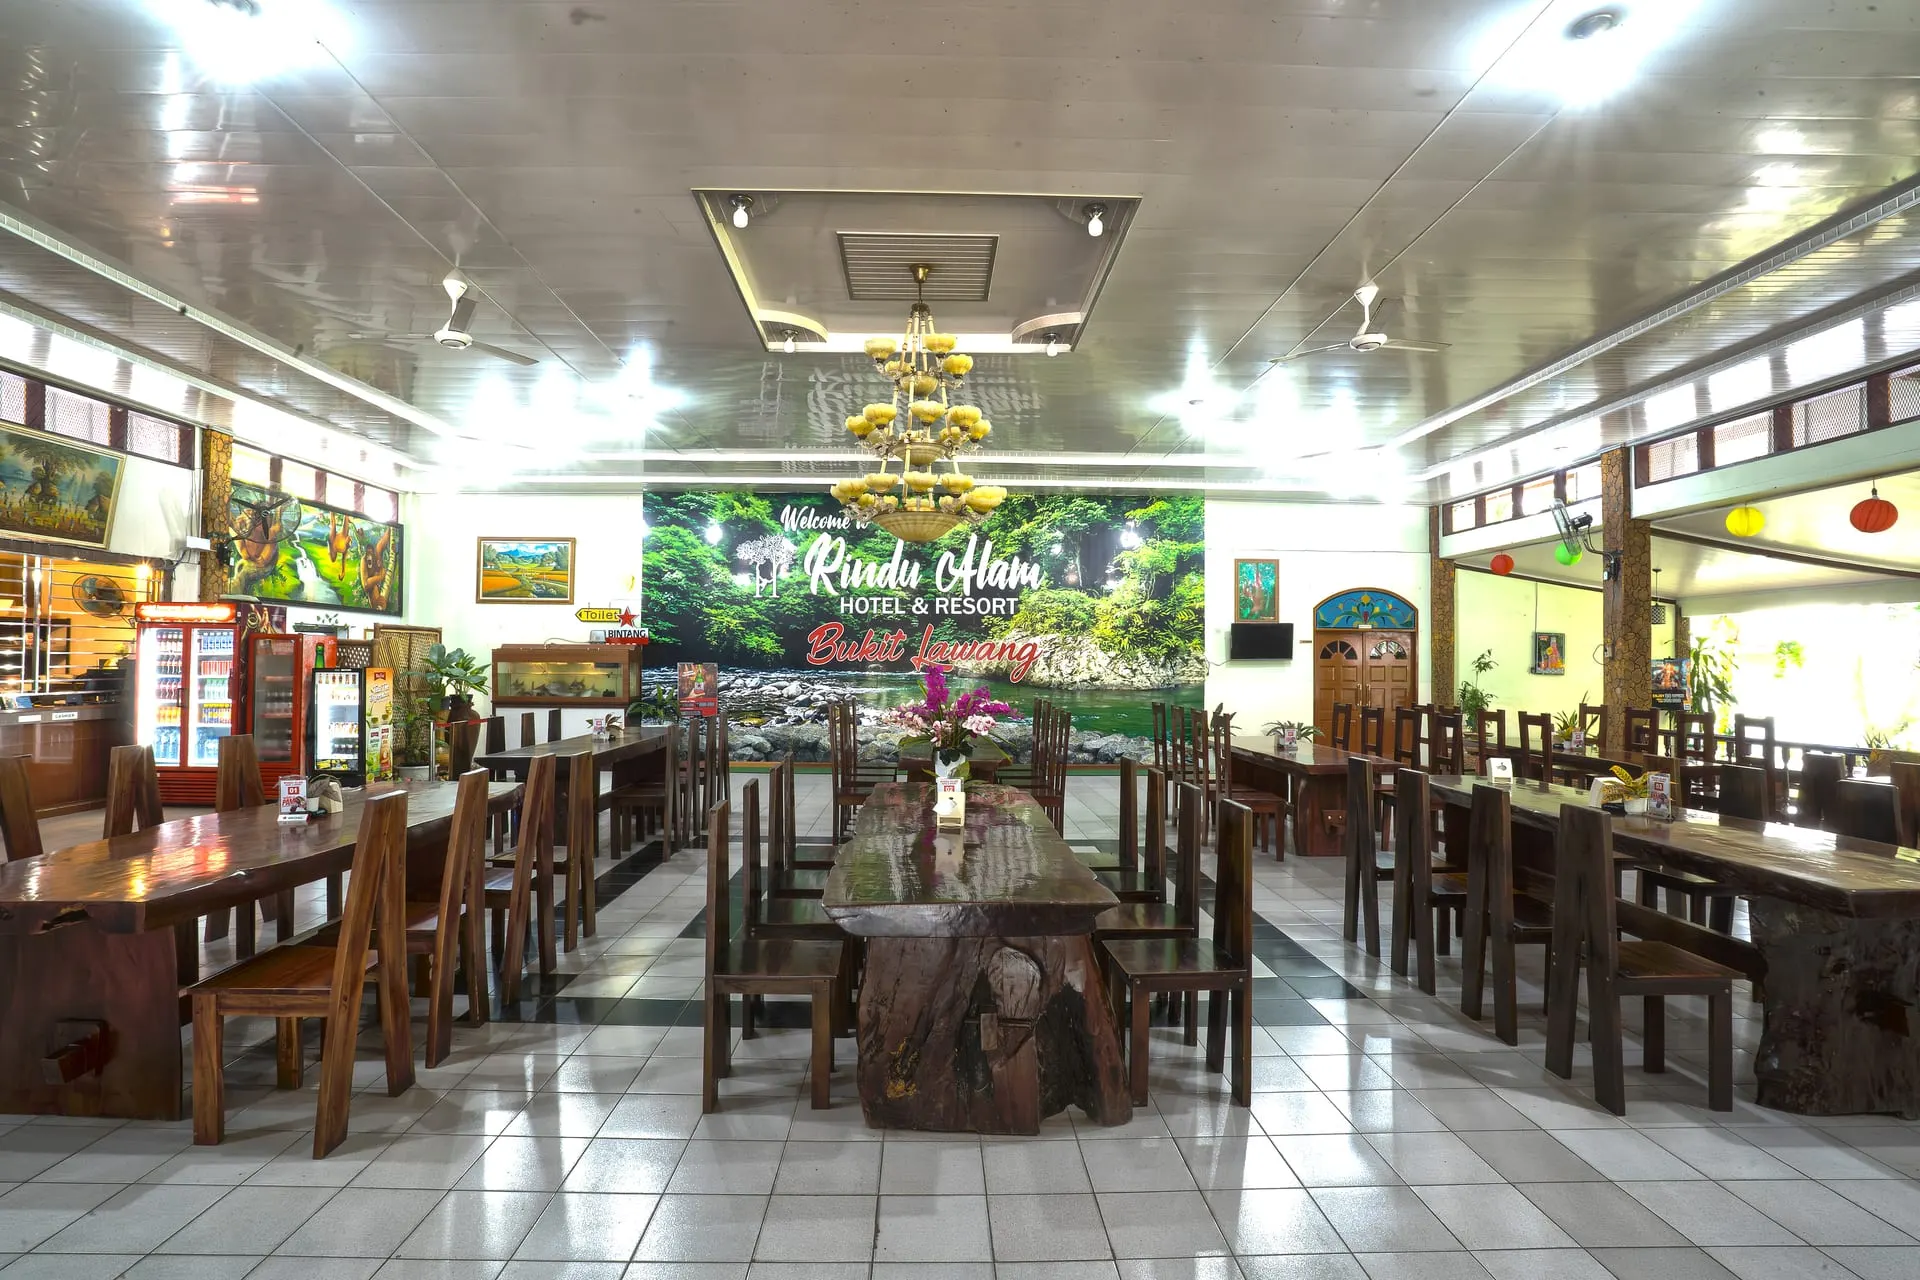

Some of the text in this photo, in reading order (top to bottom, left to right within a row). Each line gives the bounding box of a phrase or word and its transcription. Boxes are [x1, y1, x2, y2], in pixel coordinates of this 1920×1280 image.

[780, 504, 851, 532] Welcome
[803, 532, 1046, 596] Rindu Alam
[584, 610, 618, 620] Toilet
[840, 596, 1019, 615] HOTEL & RESORT
[608, 629, 646, 638] BINTANG
[806, 621, 1043, 684] Bukit Lawang
